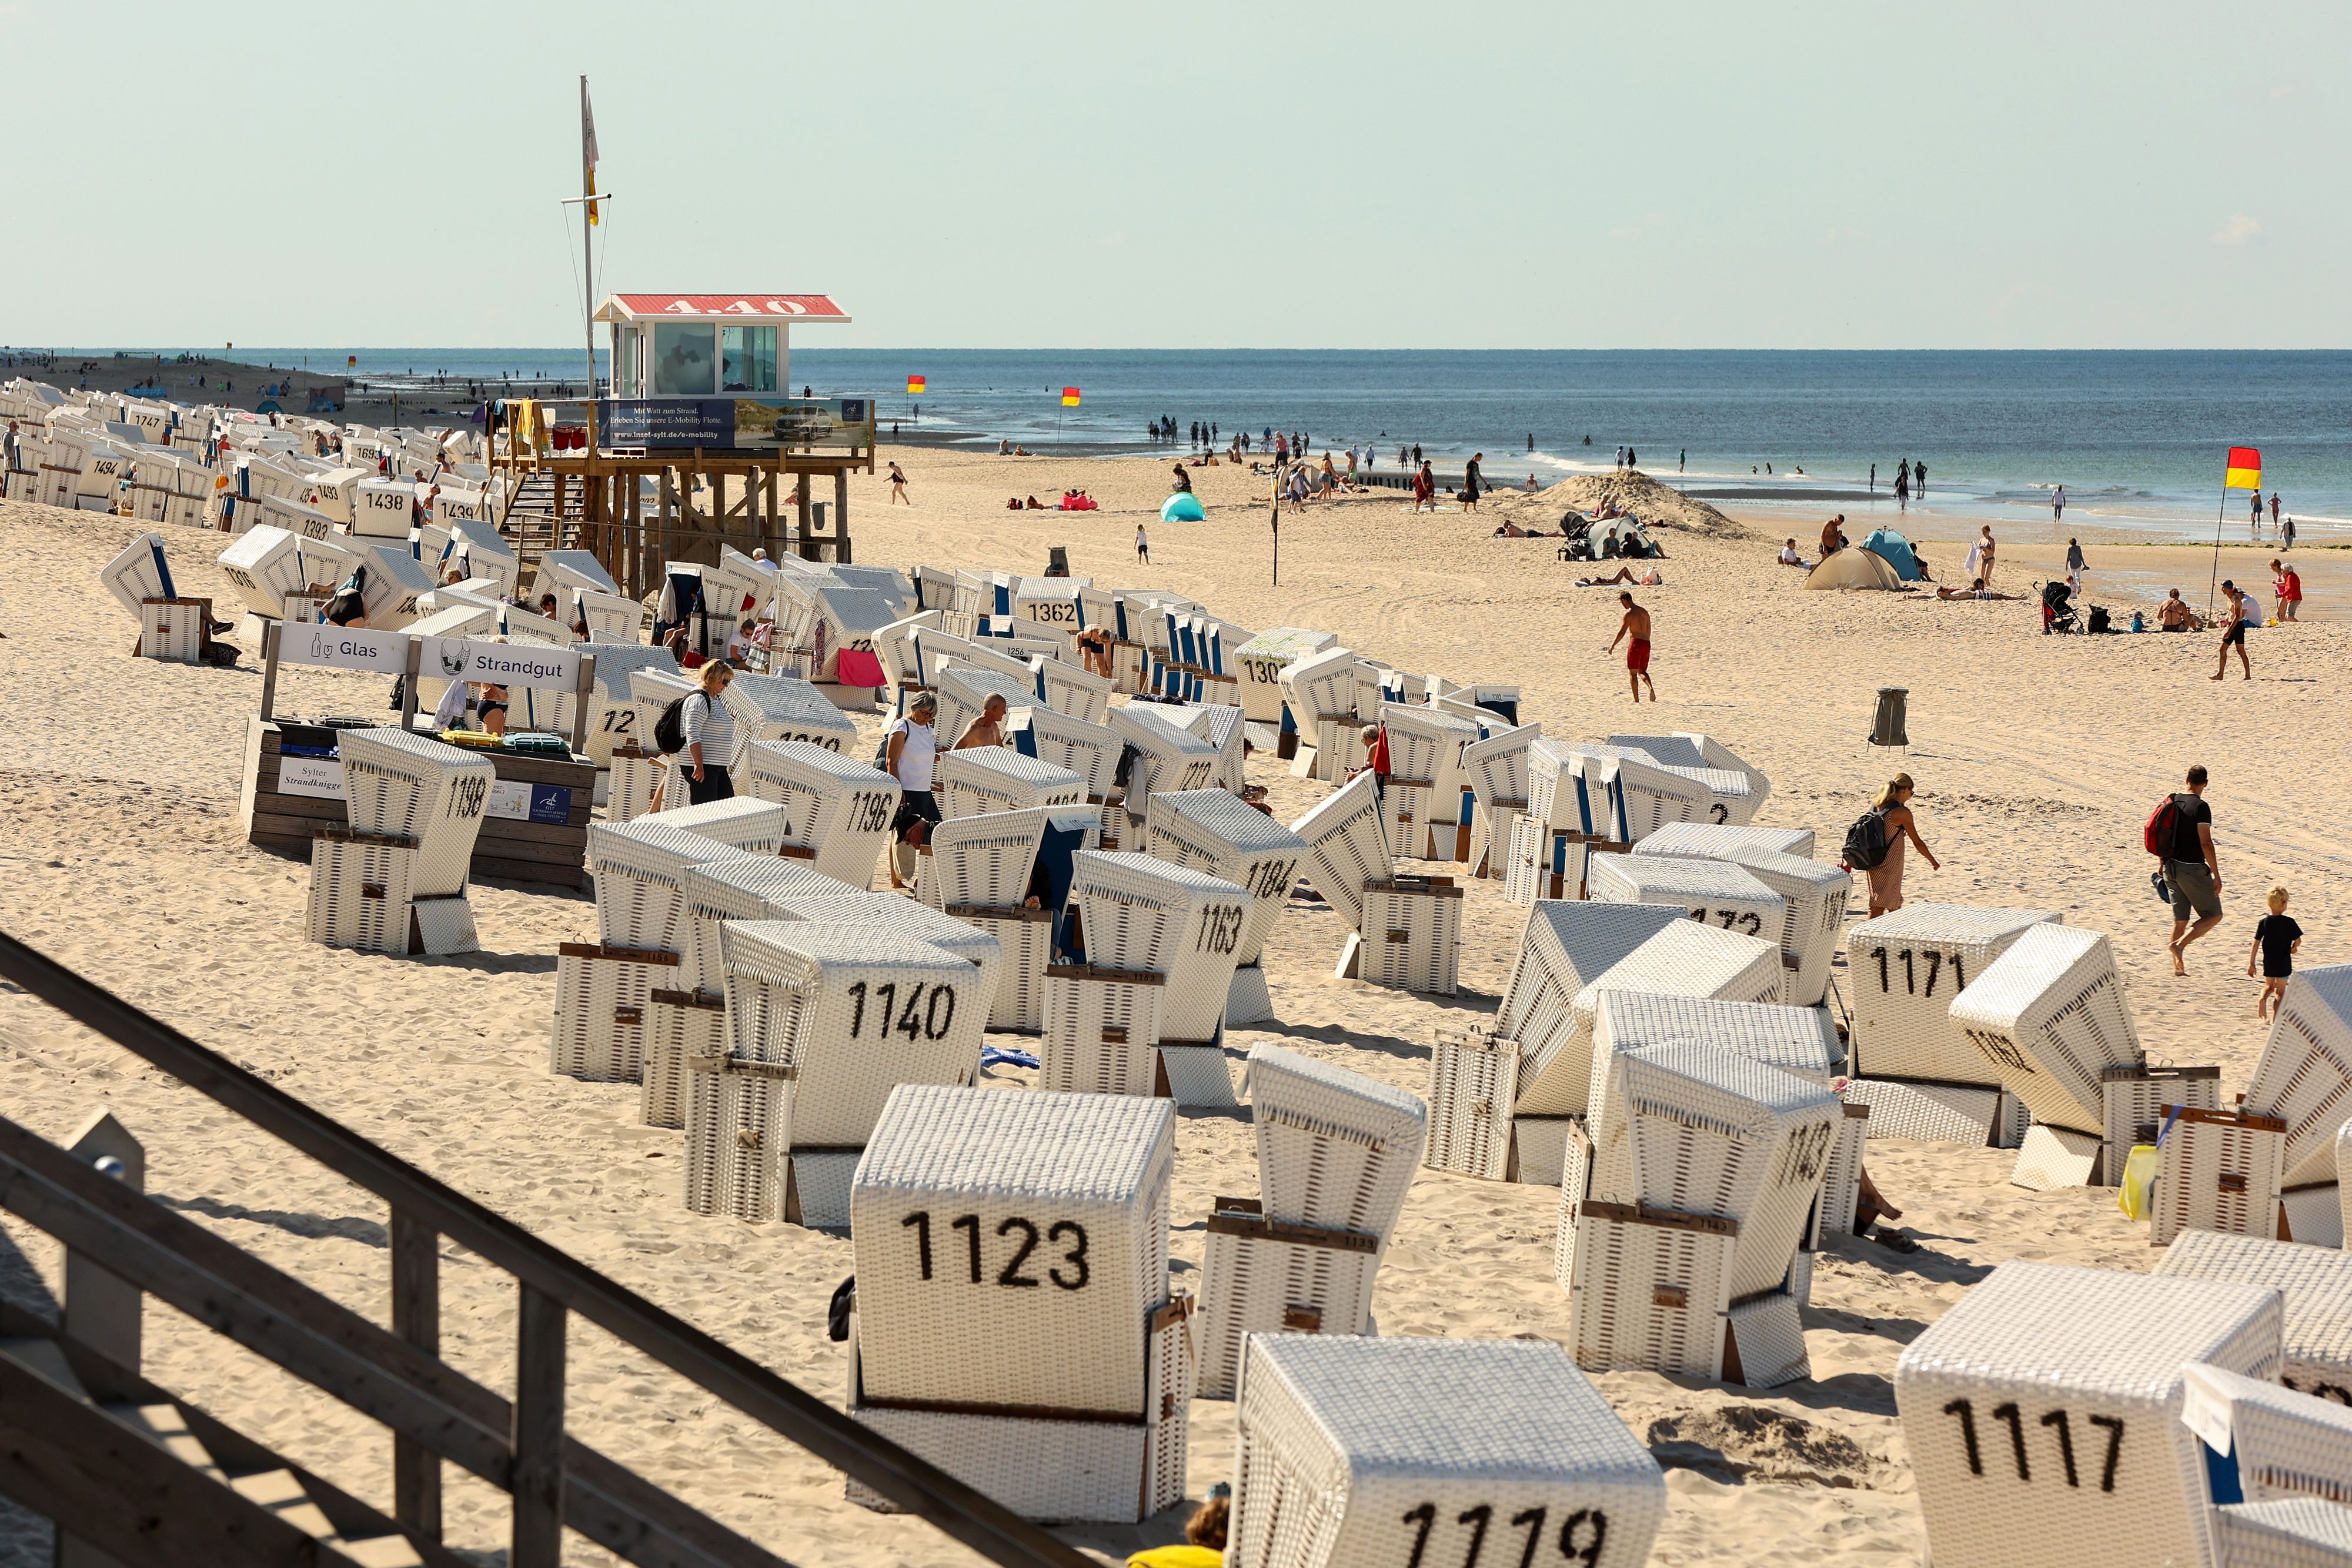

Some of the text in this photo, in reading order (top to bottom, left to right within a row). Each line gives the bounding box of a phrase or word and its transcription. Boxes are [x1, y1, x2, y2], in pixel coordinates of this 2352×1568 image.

[665, 300, 806, 314] 4.40
[136, 415, 159, 428] 1747
[614, 431, 718, 439] www.insel-sylt.de/e-mobility
[94, 460, 118, 475] 1494
[318, 484, 338, 500] 1493
[366, 493, 403, 510] 1438
[441, 503, 473, 519] 1439
[303, 519, 328, 540] 1393
[225, 567, 256, 589] 1316
[1028, 603, 1075, 622] 1362
[340, 641, 377, 657] Glas
[476, 656, 563, 678] Strandgut
[302, 767, 327, 777] Sylter
[285, 776, 342, 790] Strandknigge
[447, 774, 486, 818] 1198
[847, 791, 893, 833] 1196
[1246, 858, 1297, 899] 1184
[1196, 903, 1242, 955] 1163
[1135, 973, 1155, 982] 1163
[1870, 945, 1965, 997] 1171
[849, 981, 956, 1041] 1140
[766, 1066, 787, 1076] 1140
[2261, 1119, 2285, 1129] 1122
[902, 1211, 1089, 1290] 1123
[1345, 1235, 1374, 1249] 1133
[1943, 1398, 2124, 1493] 1117
[1402, 1503, 1608, 1568] 1119
